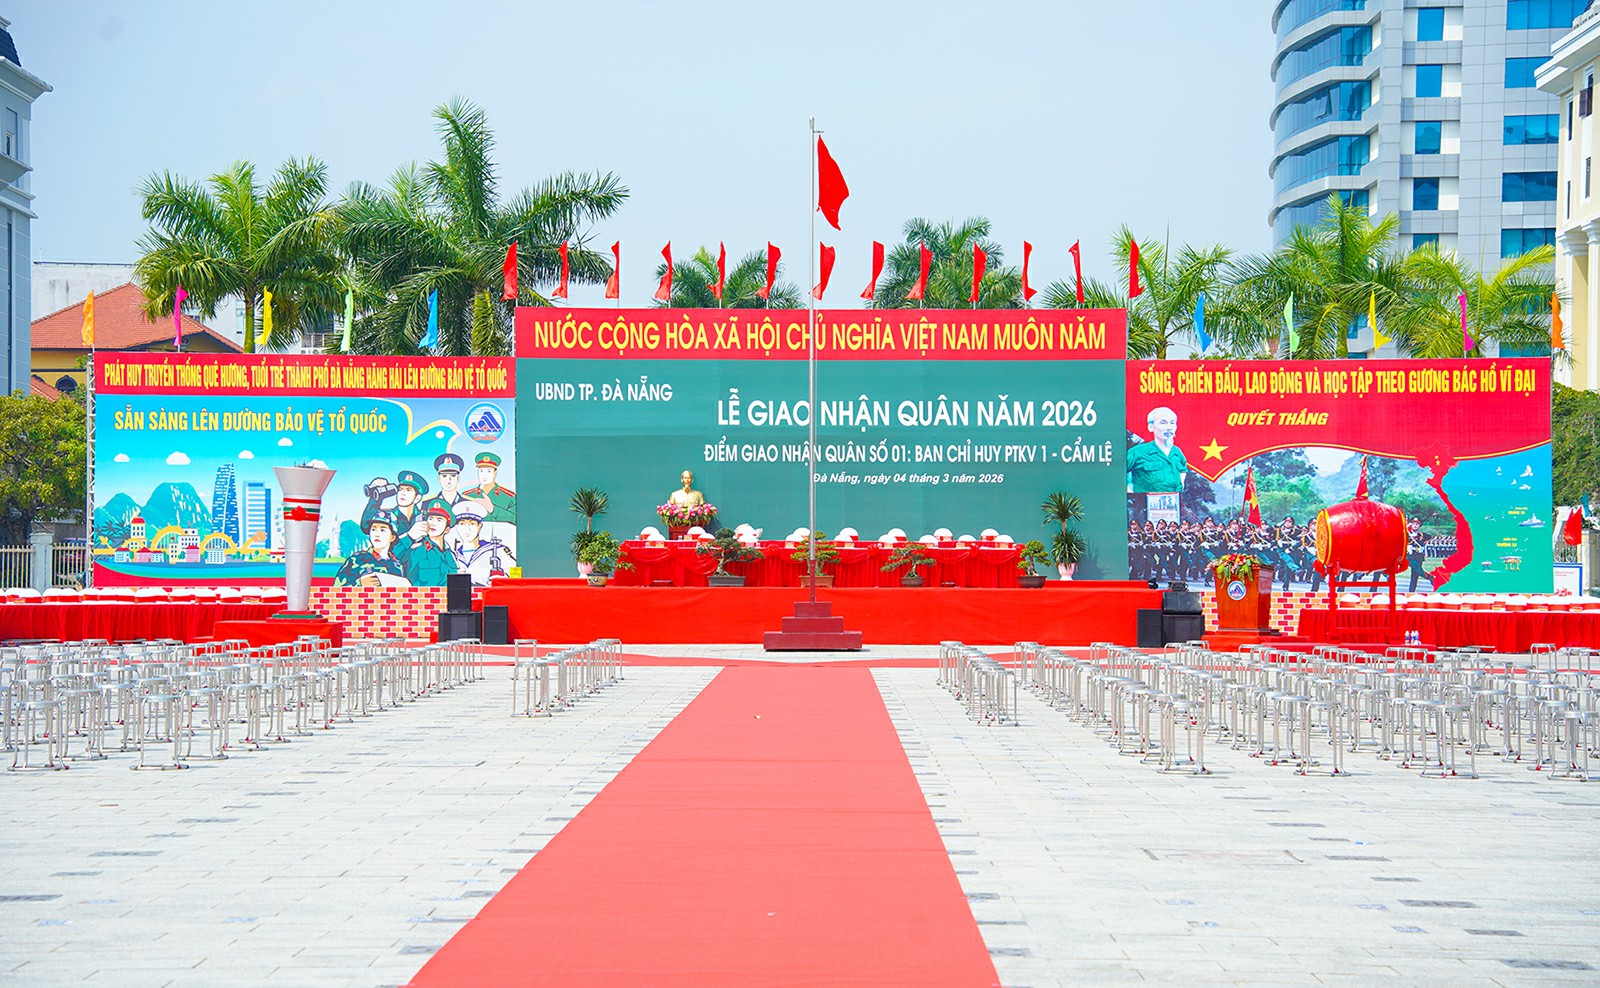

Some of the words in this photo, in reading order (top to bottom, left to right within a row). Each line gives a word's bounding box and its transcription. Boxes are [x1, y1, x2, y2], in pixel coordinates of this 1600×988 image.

[535, 313, 592, 349] NƯỚC
[598, 316, 660, 355] CỘNG
[666, 314, 709, 349] HÒA
[713, 316, 741, 349] XÃ
[747, 316, 780, 356] HỘI
[786, 312, 826, 350] CHỦ
[833, 317, 895, 350] NGHĨA
[900, 316, 937, 356] VIỆT
[943, 324, 987, 350] NAM
[994, 317, 1053, 350] MUÔN
[1060, 316, 1105, 349] NĂM
[105, 359, 125, 386] PHÁT
[127, 364, 142, 386] HUY
[144, 357, 174, 386] TRUYỀN
[176, 357, 202, 387] THỐNG
[203, 361, 219, 390] QUÊ
[221, 363, 249, 390] HƯƠNG,
[251, 357, 268, 387] TUỔI
[270, 358, 284, 387] TRẺ
[286, 361, 311, 388] THÀNH
[313, 359, 329, 388] PHỐ
[330, 362, 341, 388] ĐÀ
[343, 359, 364, 389] NẴNG
[366, 363, 387, 389] HĂNG
[389, 363, 402, 389] HÁI
[404, 363, 418, 389] LÊN
[420, 362, 446, 389] ĐƯỜNG
[448, 361, 463, 389] BẢO
[465, 363, 474, 394] VỆ
[476, 360, 485, 390] TỔ
[487, 360, 507, 392] QUỐC
[536, 383, 574, 400] UBND
[579, 384, 597, 400] TP.
[601, 379, 622, 400] ĐÀ
[628, 376, 672, 401] NẴNG
[1140, 364, 1175, 396] SỐNG,
[1178, 364, 1212, 393] CHIẾN
[1215, 364, 1242, 396] ĐẤU,
[1246, 372, 1267, 394] LAO
[1270, 367, 1302, 398] ĐỘNG
[1305, 367, 1321, 393] VÀ
[1324, 371, 1347, 398] HỌC
[1350, 367, 1372, 398] TẬP
[1376, 371, 1405, 393] THEO
[1409, 368, 1449, 393] GƯƠNG
[1453, 365, 1477, 392] BÁC
[1481, 362, 1496, 392] HỒ
[1500, 365, 1512, 391] VĨ
[1515, 370, 1535, 396] ĐẠI
[115, 405, 144, 430] SẴN
[149, 408, 187, 430] SÀNG
[193, 408, 218, 430] LÊN
[223, 408, 270, 431] ĐƯỜNG
[276, 407, 303, 431] BẢO
[308, 409, 324, 435] VỆ
[329, 406, 346, 431] TỔ
[350, 408, 386, 434] QUỐC
[718, 388, 740, 425] LỄ
[747, 399, 810, 427] GIAO
[821, 395, 889, 432] NHẬN
[898, 395, 968, 426] QUÂN
[978, 395, 1034, 426] NĂM
[1042, 401, 1096, 426] 2026
[1227, 409, 1276, 426] QUYẾT
[1279, 408, 1329, 425] THẮNG
[704, 436, 737, 461] ĐIỂM
[742, 445, 778, 462] GIAO
[782, 441, 822, 467] NHẬN
[825, 441, 865, 462] QUÂN
[870, 438, 888, 462] SỐ
[892, 445, 910, 462] 01:
[915, 445, 942, 462] BAN
[947, 439, 971, 462] CHỈ
[975, 446, 1001, 462] HUY
[1005, 446, 1036, 462] PTKV
[1041, 445, 1047, 462] 1
[1061, 437, 1094, 462] CẨM
[1099, 441, 1111, 466] LỆ
[813, 473, 828, 483] Đà
[864, 473, 891, 484] ngày
[893, 474, 906, 482] 04
[909, 473, 940, 484] tháng
[943, 474, 949, 482] 3
[952, 474, 975, 482] năm
[978, 474, 1004, 483] 2026
